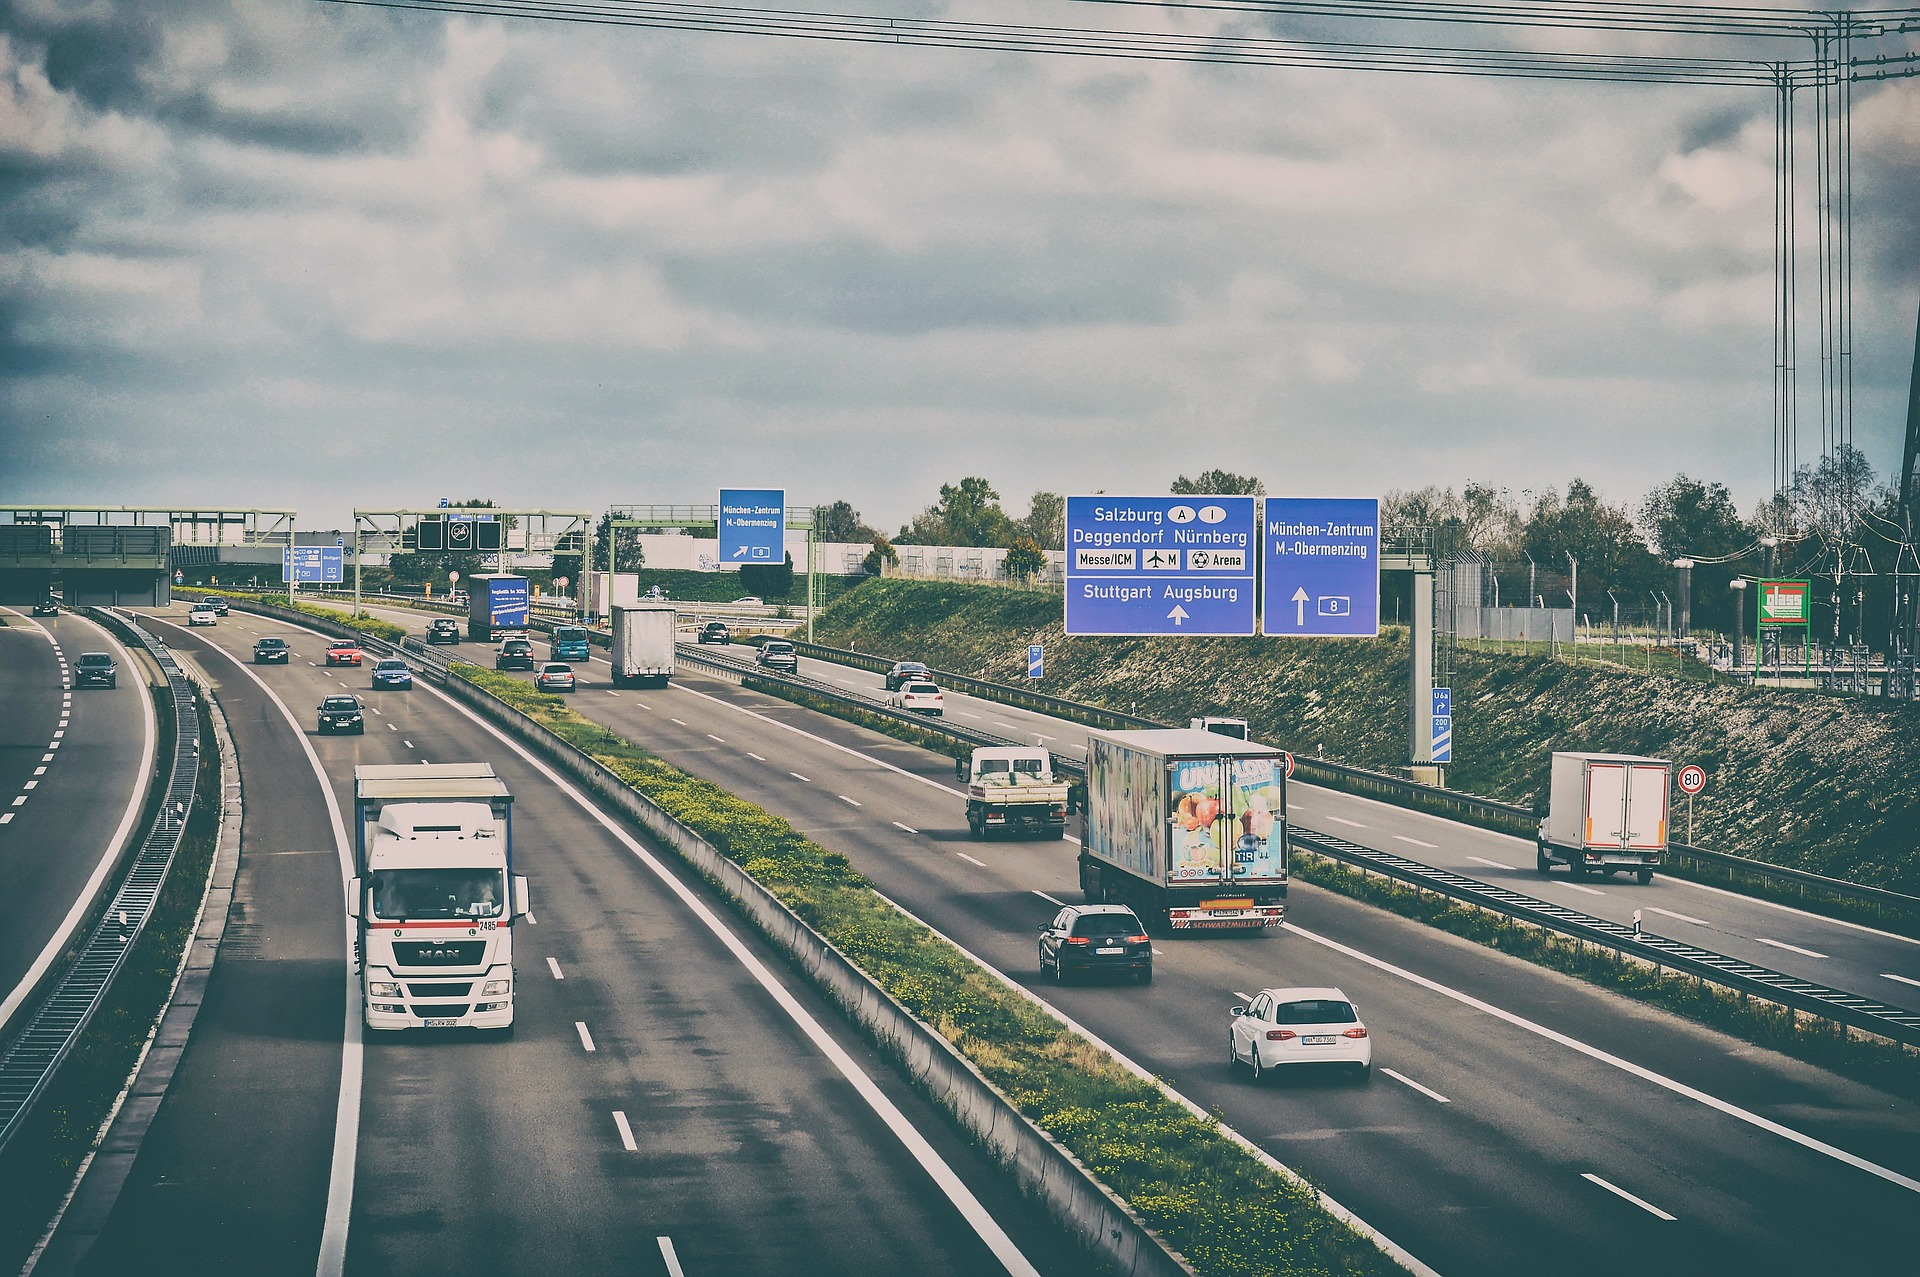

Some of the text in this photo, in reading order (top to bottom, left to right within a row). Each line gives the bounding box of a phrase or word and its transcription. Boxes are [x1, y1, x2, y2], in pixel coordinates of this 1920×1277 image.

[723, 505, 780, 515] München-Zentrum
[1094, 507, 1163, 525] Salzburg
[1177, 509, 1187, 520] A
[1269, 521, 1374, 537] München-Zentrum
[1073, 529, 1248, 547] Deggendorf Nürnberg
[1275, 541, 1367, 560] M.-Obermenzing
[1080, 553, 1132, 566] Messe/ICM
[1168, 554, 1177, 565] M
[1213, 554, 1241, 566] Arena
[1083, 584, 1238, 602] Stuttgart Augsburg
[1330, 600, 1338, 612] 8
[1684, 773, 1700, 786] 80
[1236, 851, 1254, 862] TIR
[479, 921, 496, 931] 2485
[418, 949, 460, 959] MAN
